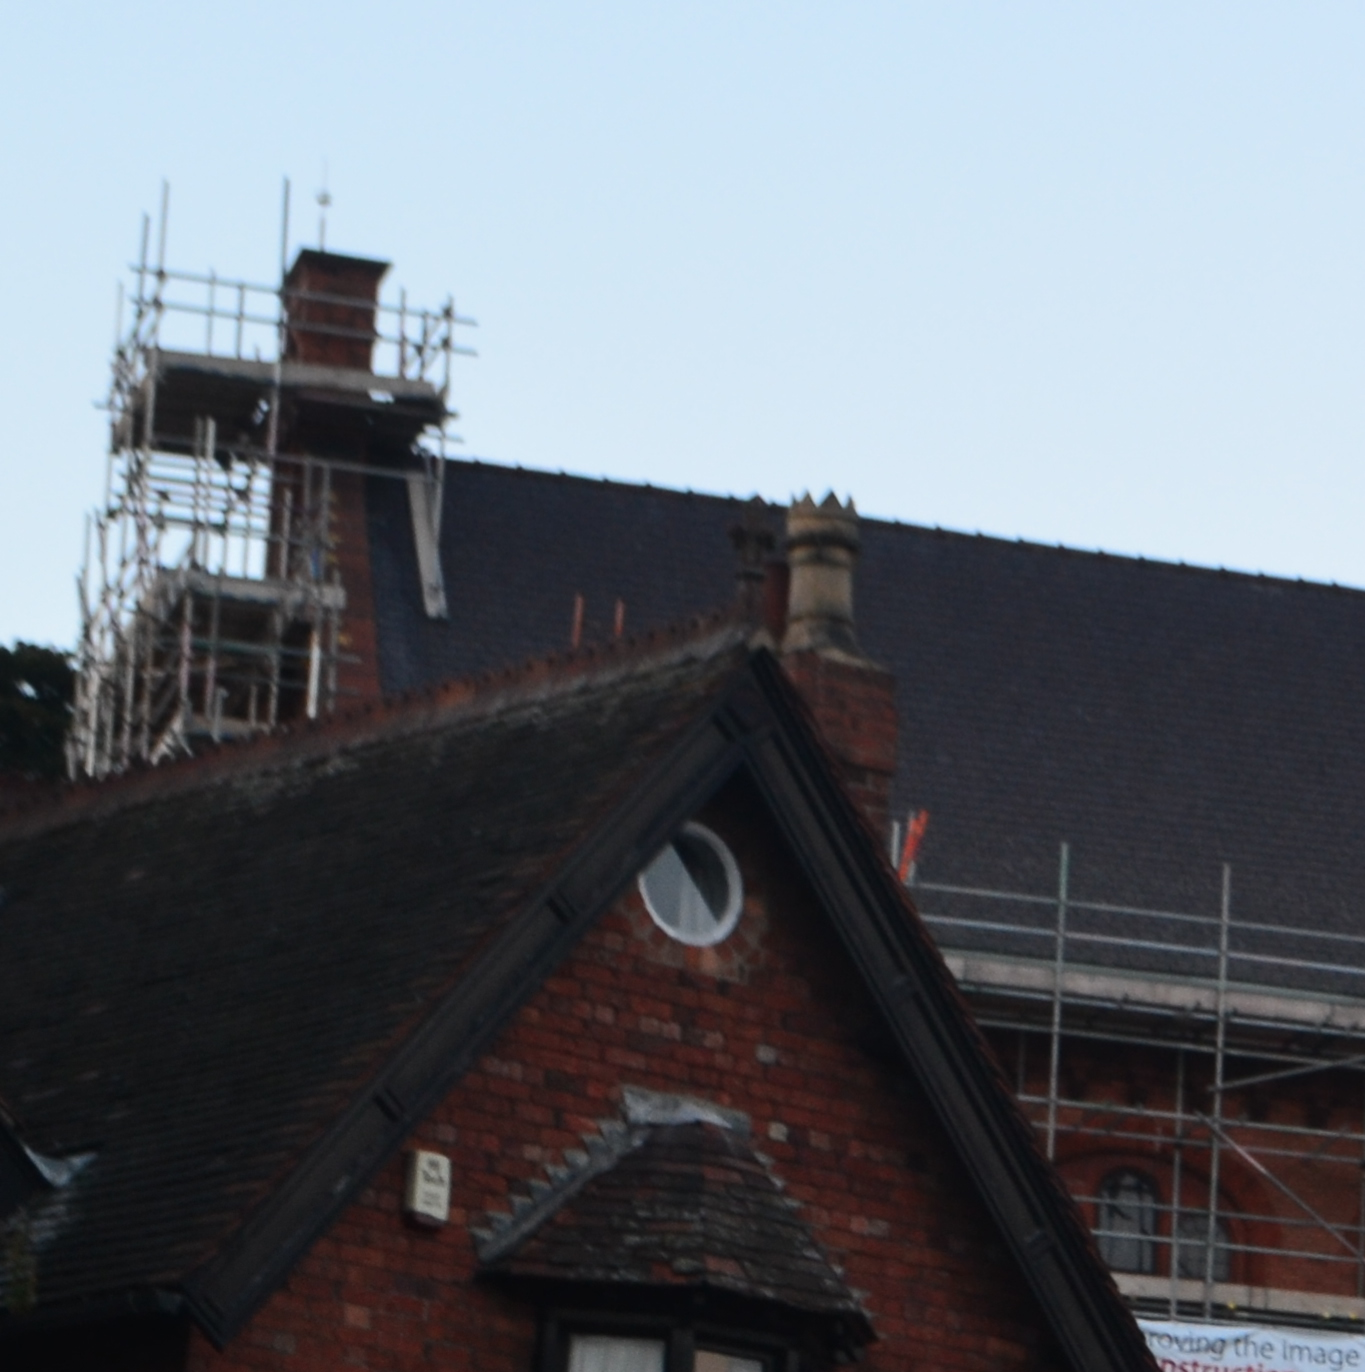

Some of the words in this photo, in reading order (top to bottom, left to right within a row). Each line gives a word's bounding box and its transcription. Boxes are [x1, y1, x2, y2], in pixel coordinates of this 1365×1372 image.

[1147, 1331, 1226, 1361] roving
[1233, 1335, 1274, 1360] the
[1282, 1338, 1360, 1372] image
